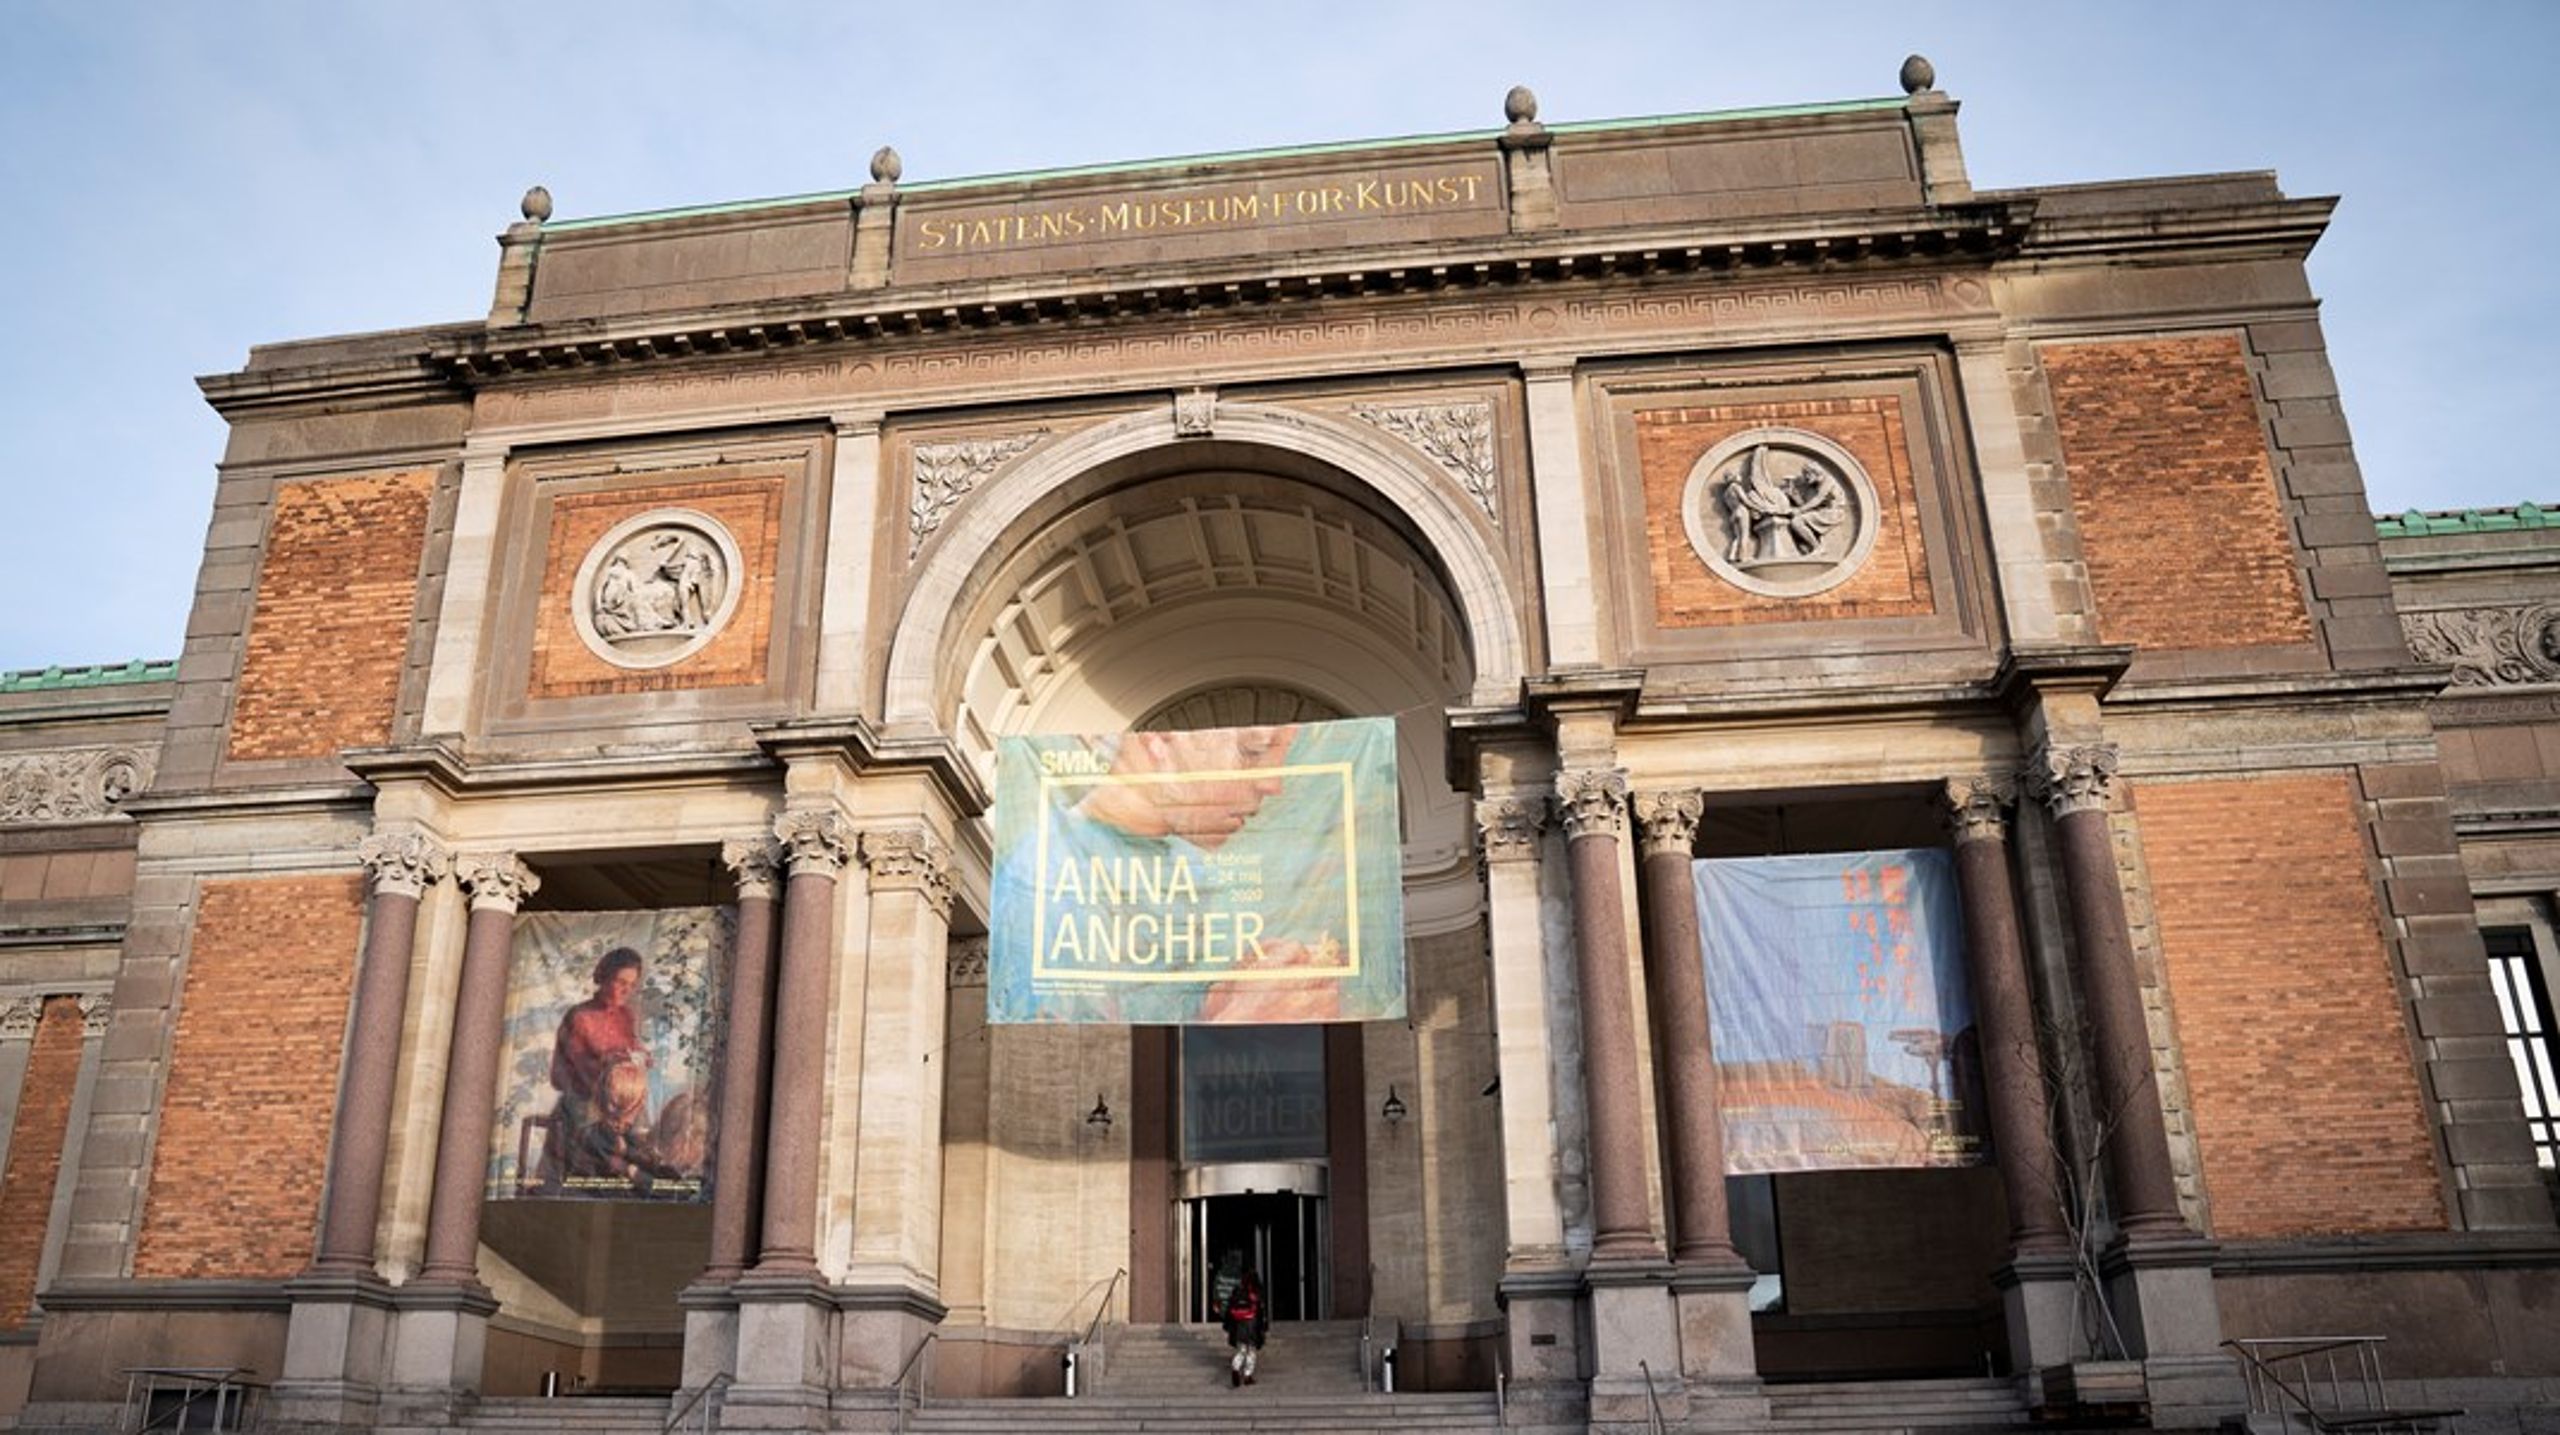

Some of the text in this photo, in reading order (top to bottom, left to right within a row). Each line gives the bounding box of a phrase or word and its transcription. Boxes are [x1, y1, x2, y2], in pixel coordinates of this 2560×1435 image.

[1101, 193, 1259, 233] MUSEUM
[1273, 187, 1344, 217] FOR
[1357, 174, 1483, 210] KUNST
[1051, 855, 1200, 906] ANNA
[1049, 911, 1269, 965] ANCHER
